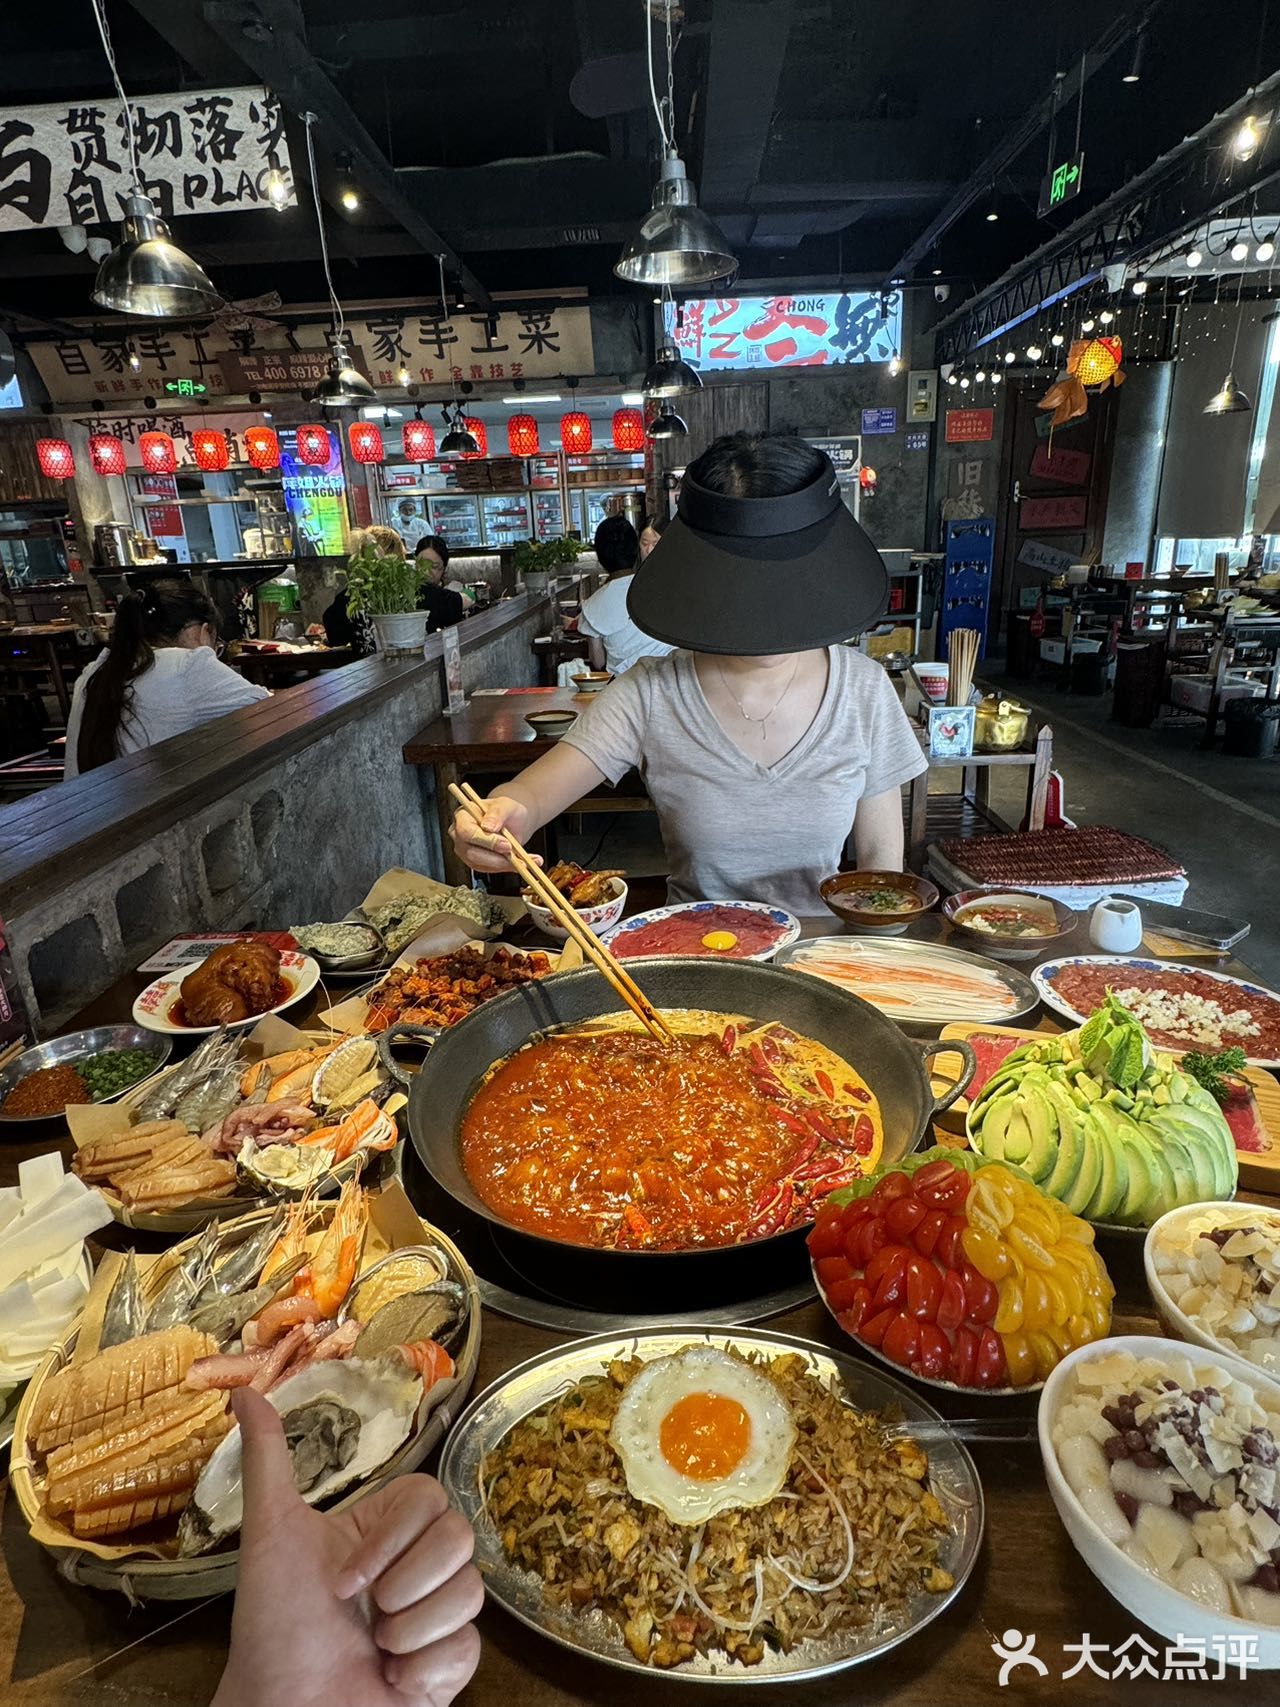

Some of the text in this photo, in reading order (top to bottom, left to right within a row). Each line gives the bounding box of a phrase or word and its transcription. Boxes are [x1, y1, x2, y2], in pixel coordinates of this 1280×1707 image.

[776, 298, 826, 313] CHONG
[244, 371, 263, 381] TEL
[264, 367, 287, 380] 400
[290, 366, 321, 379] 6978
[288, 486, 343, 499] CHENGDU
